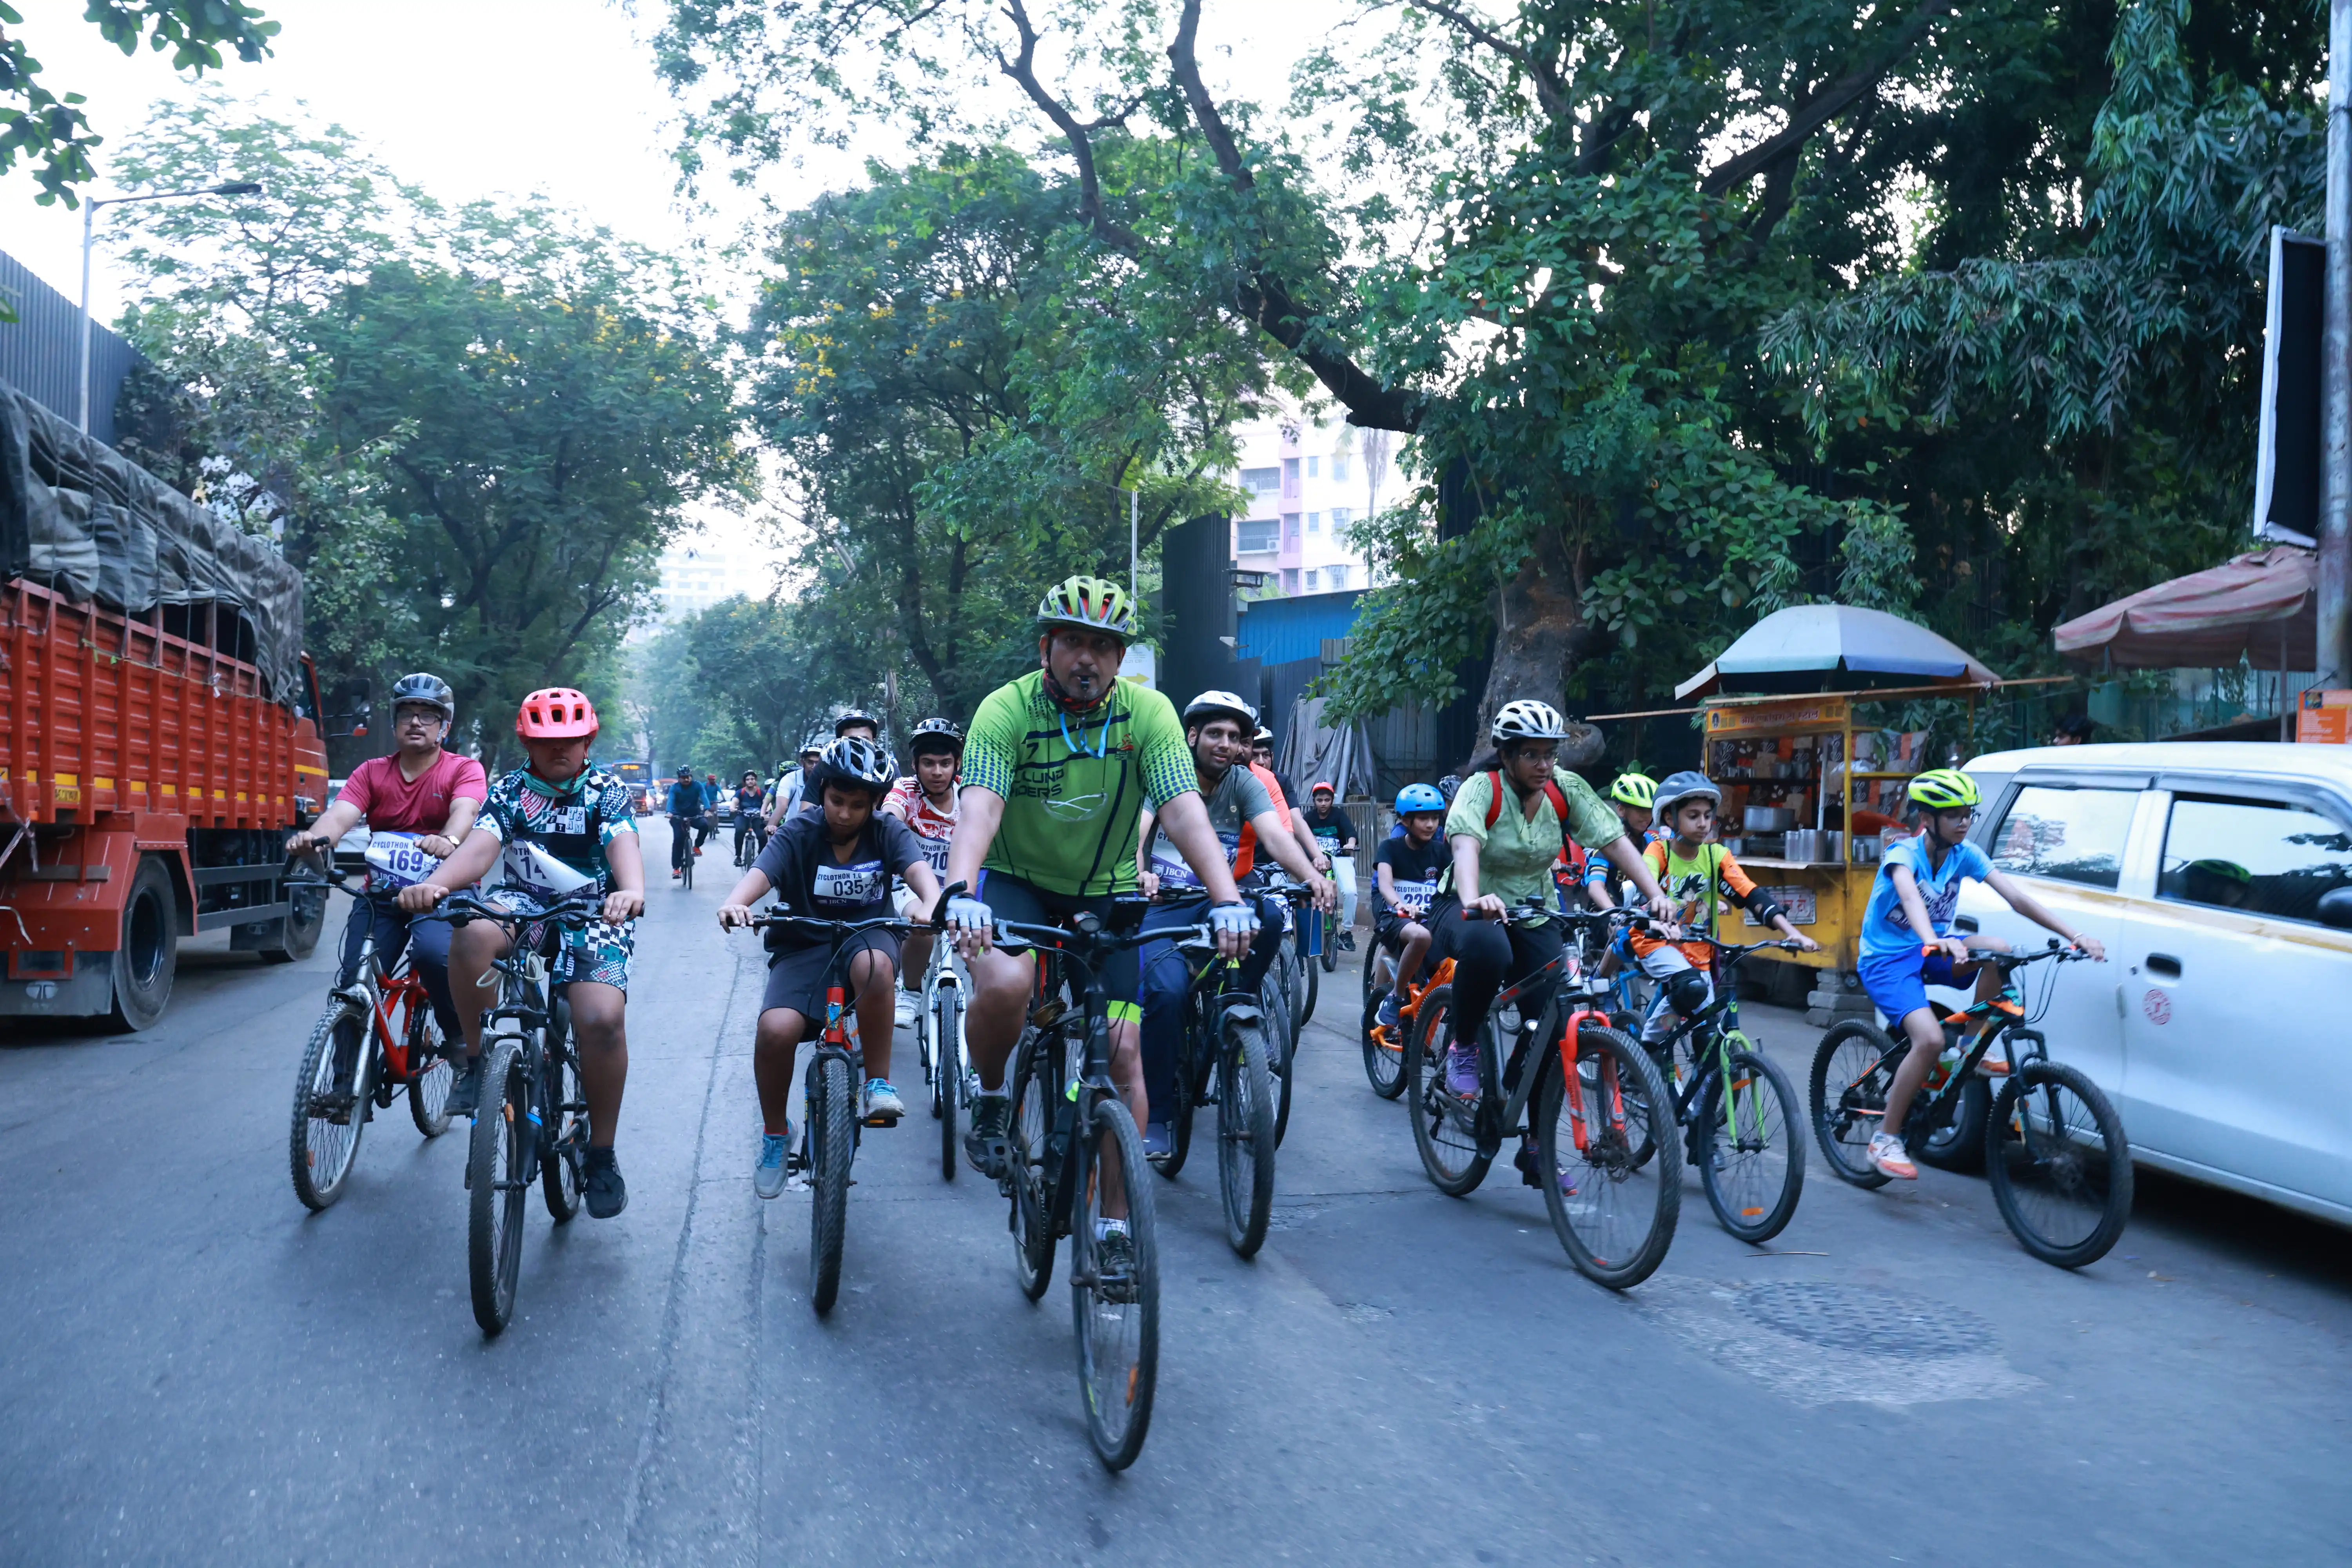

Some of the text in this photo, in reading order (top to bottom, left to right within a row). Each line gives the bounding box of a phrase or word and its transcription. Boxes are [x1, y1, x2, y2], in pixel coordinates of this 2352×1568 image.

[1015, 769, 1064, 784] LUND
[389, 849, 423, 872] 169
[857, 860, 881, 869] DECATHLON
[1163, 866, 1188, 878] JBCN
[834, 879, 863, 897] 035
